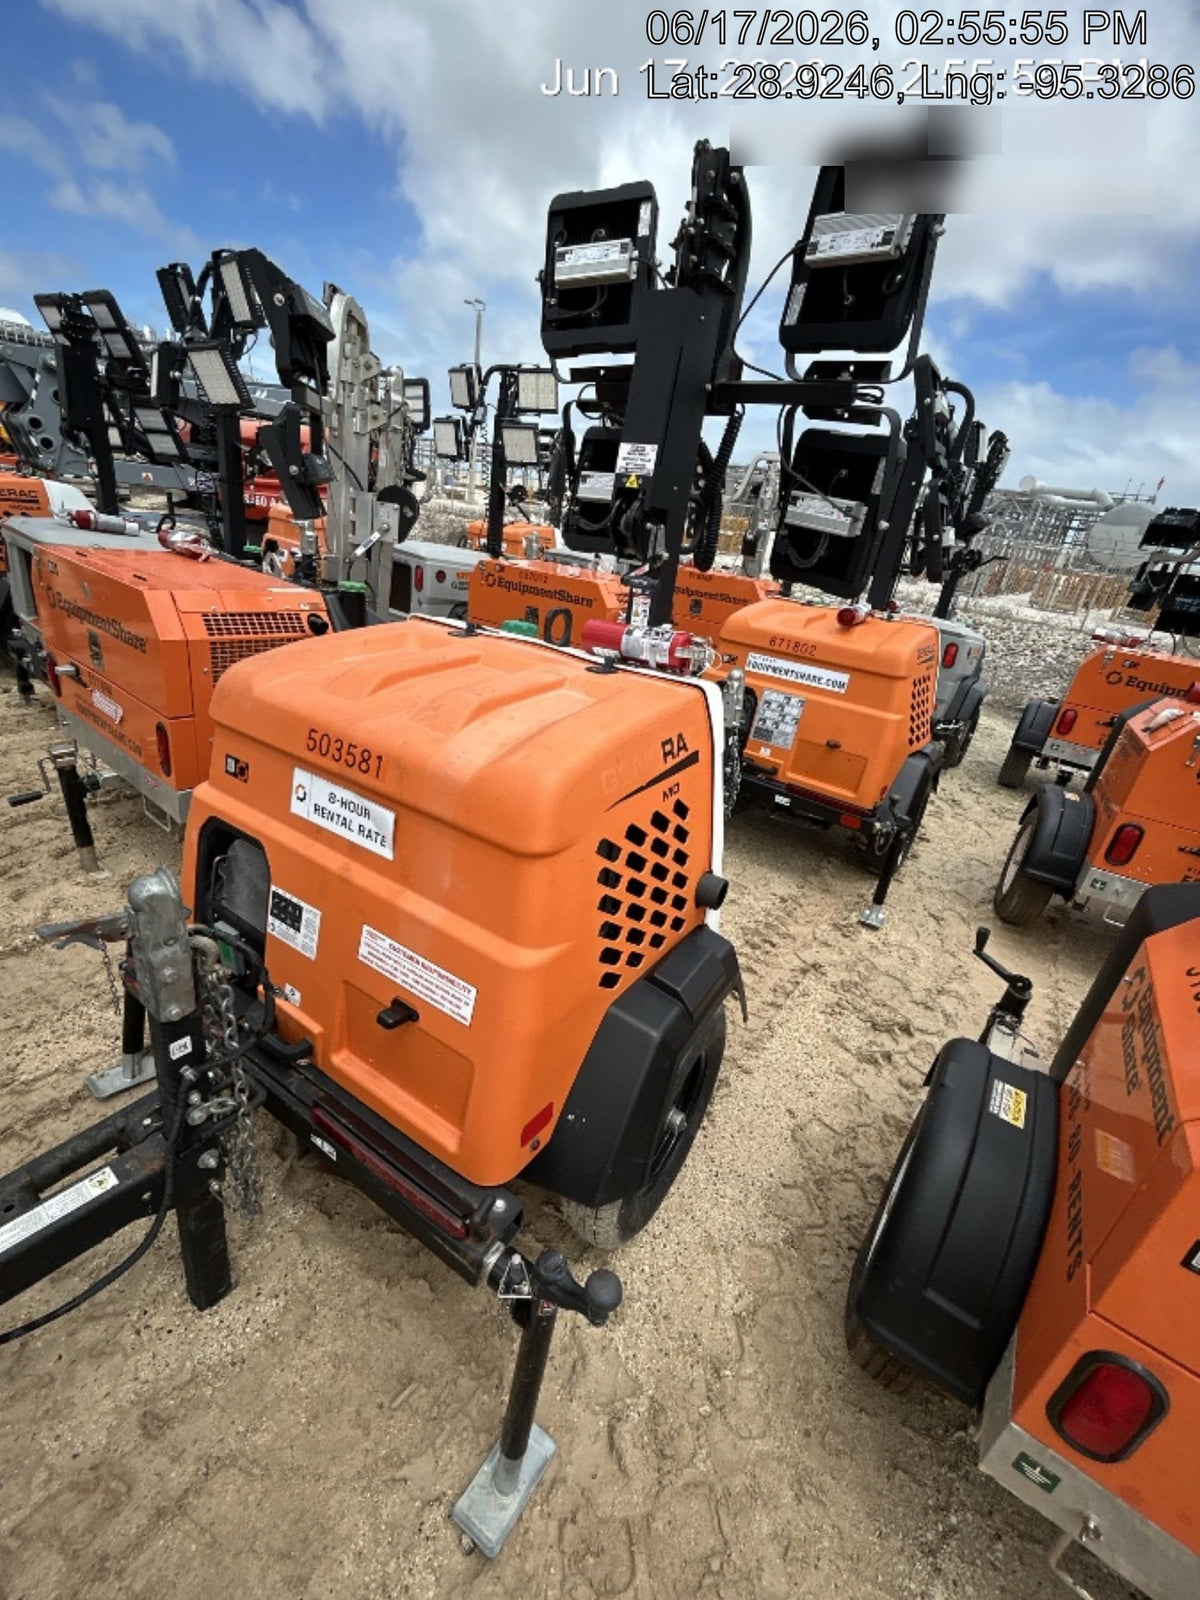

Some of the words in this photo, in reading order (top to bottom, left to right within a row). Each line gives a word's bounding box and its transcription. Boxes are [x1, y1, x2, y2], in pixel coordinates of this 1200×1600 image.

[497, 577, 594, 608] EquipmentShare
[769, 636, 817, 657] 671802
[307, 728, 383, 779] 503581
[313, 803, 354, 832] RENTAL
[358, 824, 387, 848] RATE
[328, 792, 371, 821] 8-HOUR
[1122, 1012, 1139, 1097] Share
[1138, 981, 1175, 1148] Equipment
